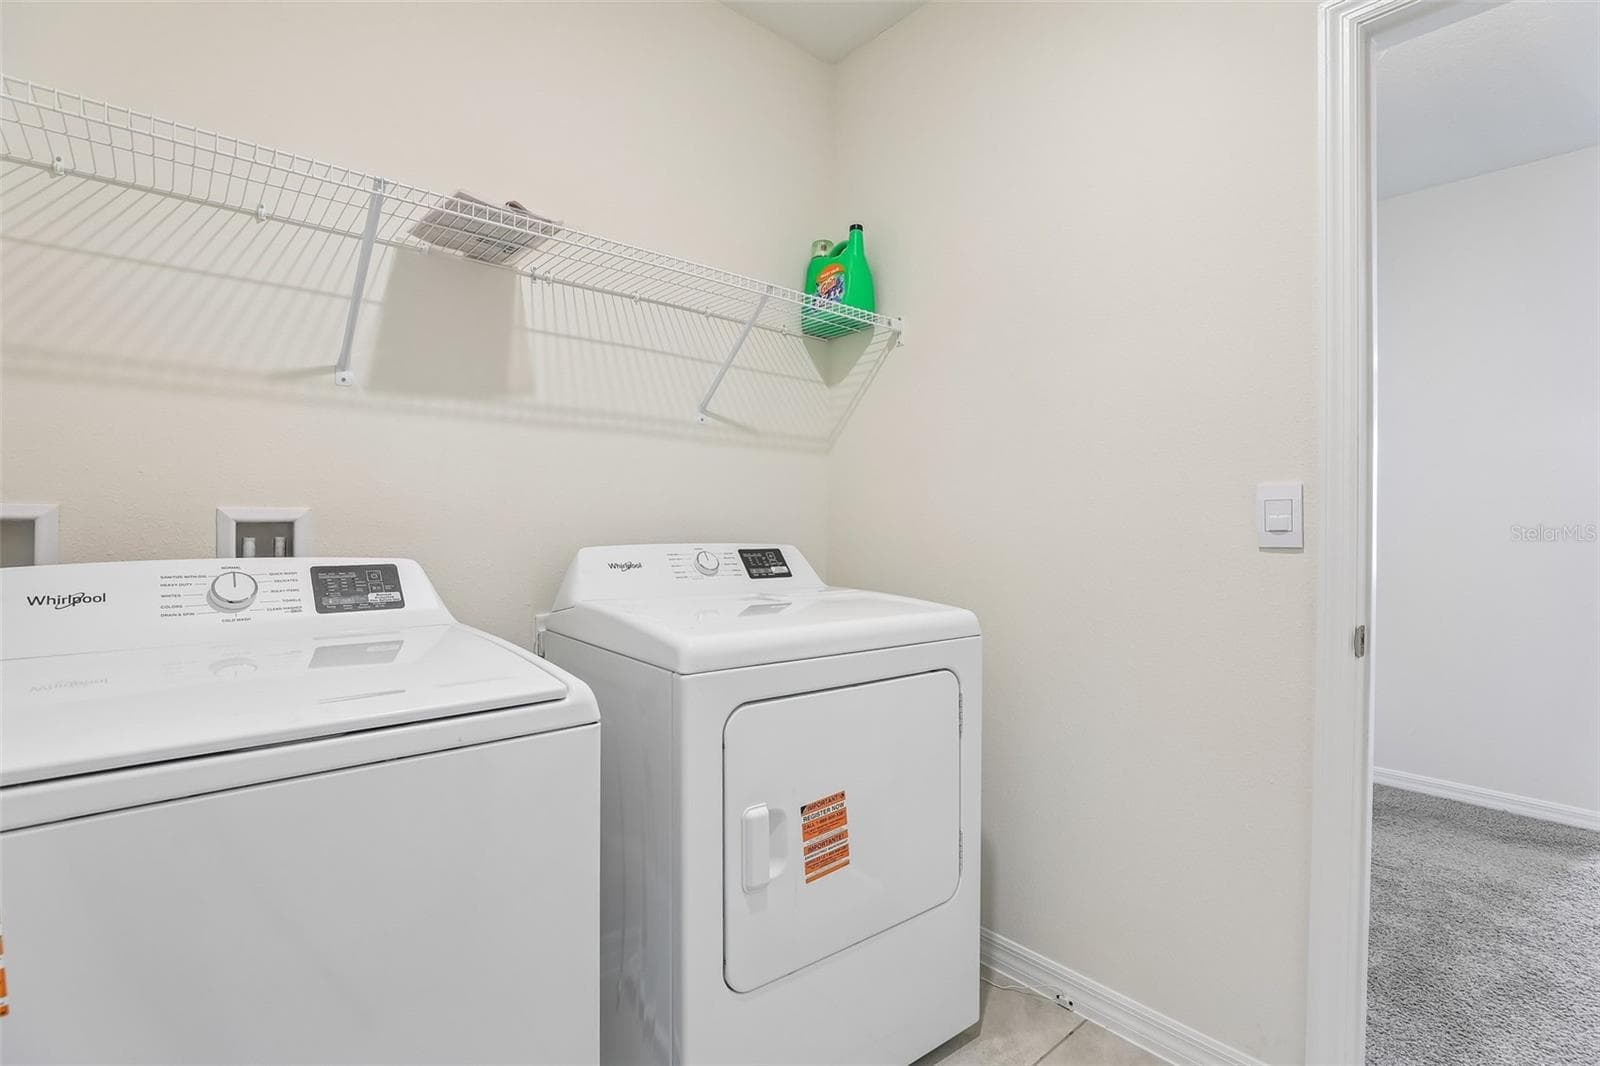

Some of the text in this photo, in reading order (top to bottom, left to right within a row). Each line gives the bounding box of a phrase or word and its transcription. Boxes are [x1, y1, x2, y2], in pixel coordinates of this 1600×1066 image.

[607, 560, 643, 572] Whirlpool
[26, 591, 107, 610] Whirlpool
[803, 807, 831, 822] REGISTER
[832, 801, 845, 811] NOW
